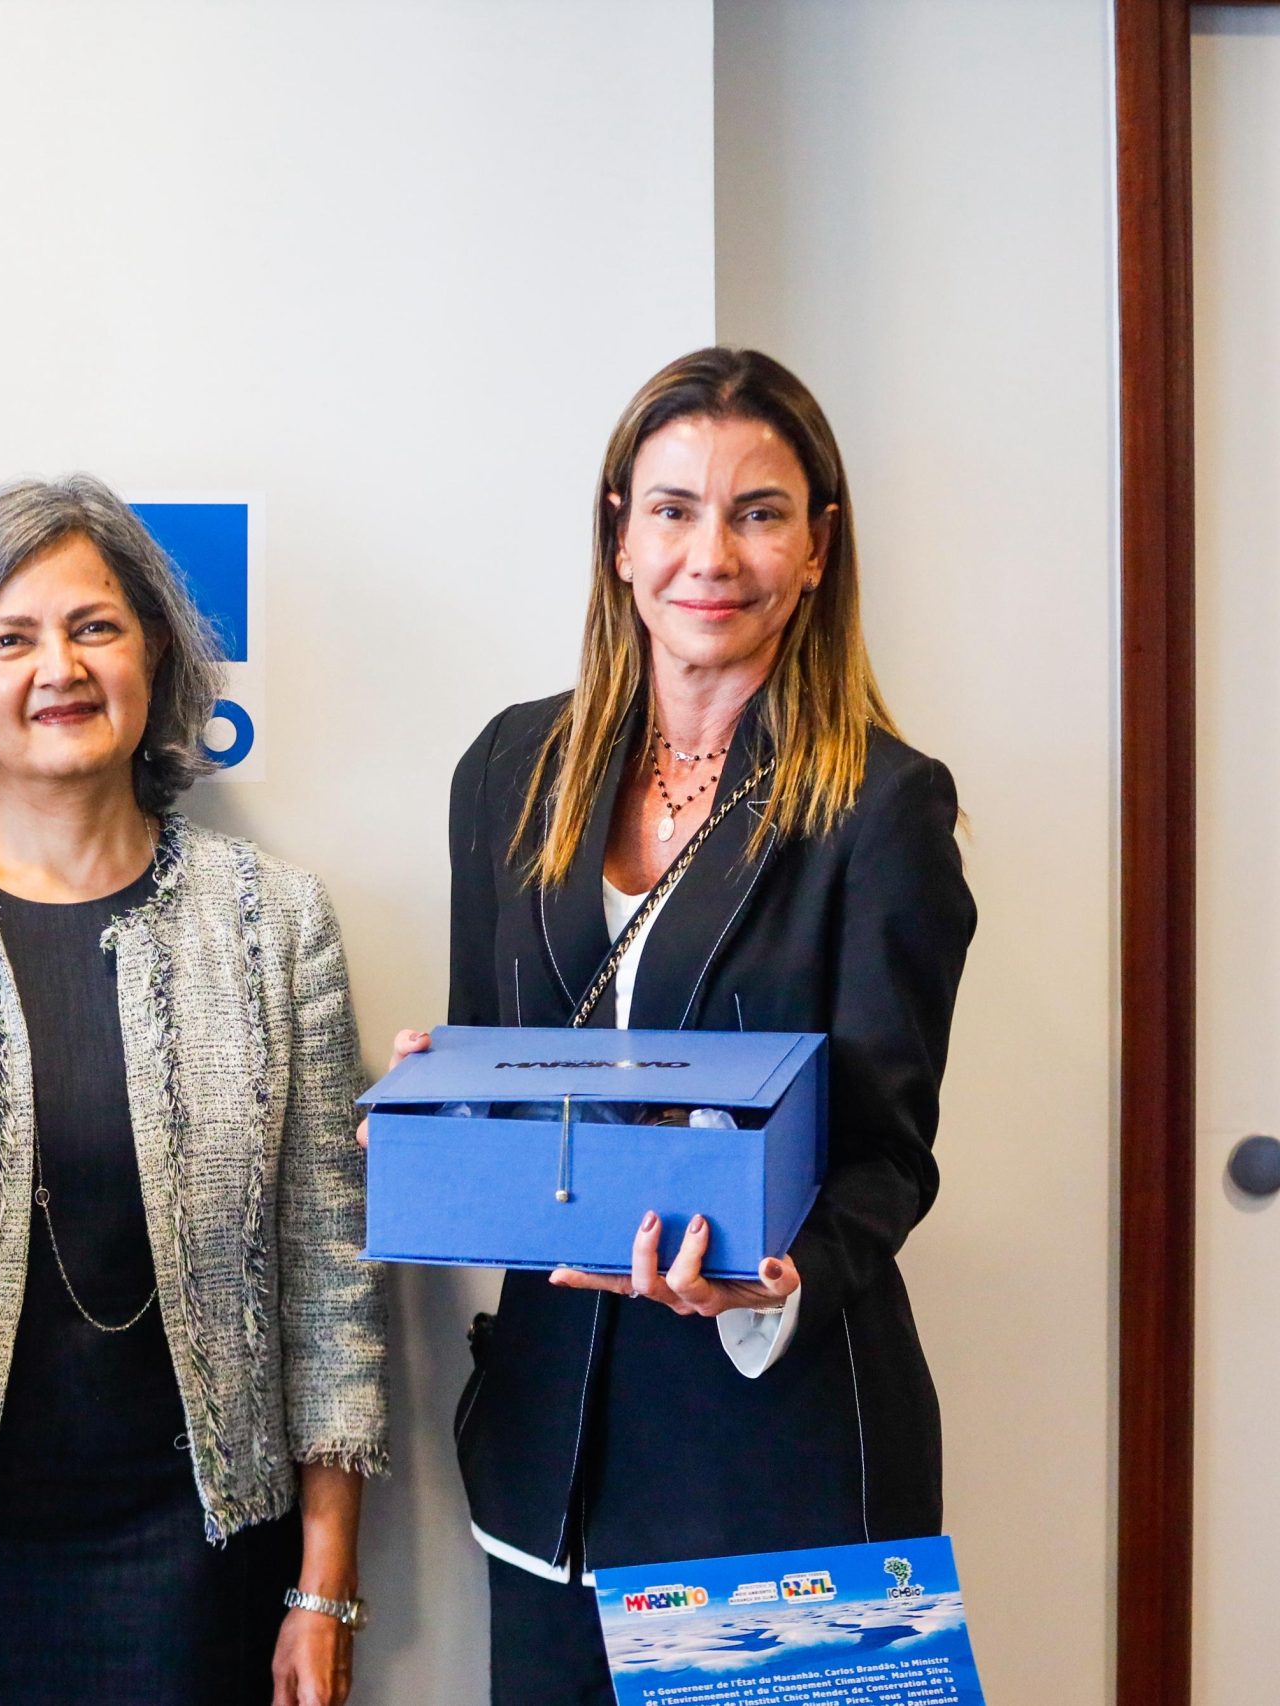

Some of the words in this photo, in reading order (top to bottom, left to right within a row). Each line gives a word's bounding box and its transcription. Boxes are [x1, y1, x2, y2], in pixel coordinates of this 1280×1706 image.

[643, 1689, 655, 1697] Le
[657, 1684, 713, 1696] Gouverneur
[716, 1681, 729, 1689] de
[759, 1676, 771, 1685] du
[824, 1668, 855, 1677] Carlos
[911, 1656, 949, 1667] Ministre
[661, 1690, 740, 1706] l'Environnement
[757, 1687, 769, 1695] du
[772, 1680, 832, 1693] Changement
[891, 1669, 923, 1679] Marina
[783, 1693, 809, 1702] Chico
[812, 1689, 849, 1699] Mendes
[851, 1686, 863, 1694] de
[866, 1680, 927, 1693] Conservation
[930, 1677, 942, 1685] de
[945, 1675, 954, 1683] la
[879, 1693, 901, 1701] vous
[907, 1687, 944, 1698] invitent
[907, 1695, 959, 1706] Patrimoine
